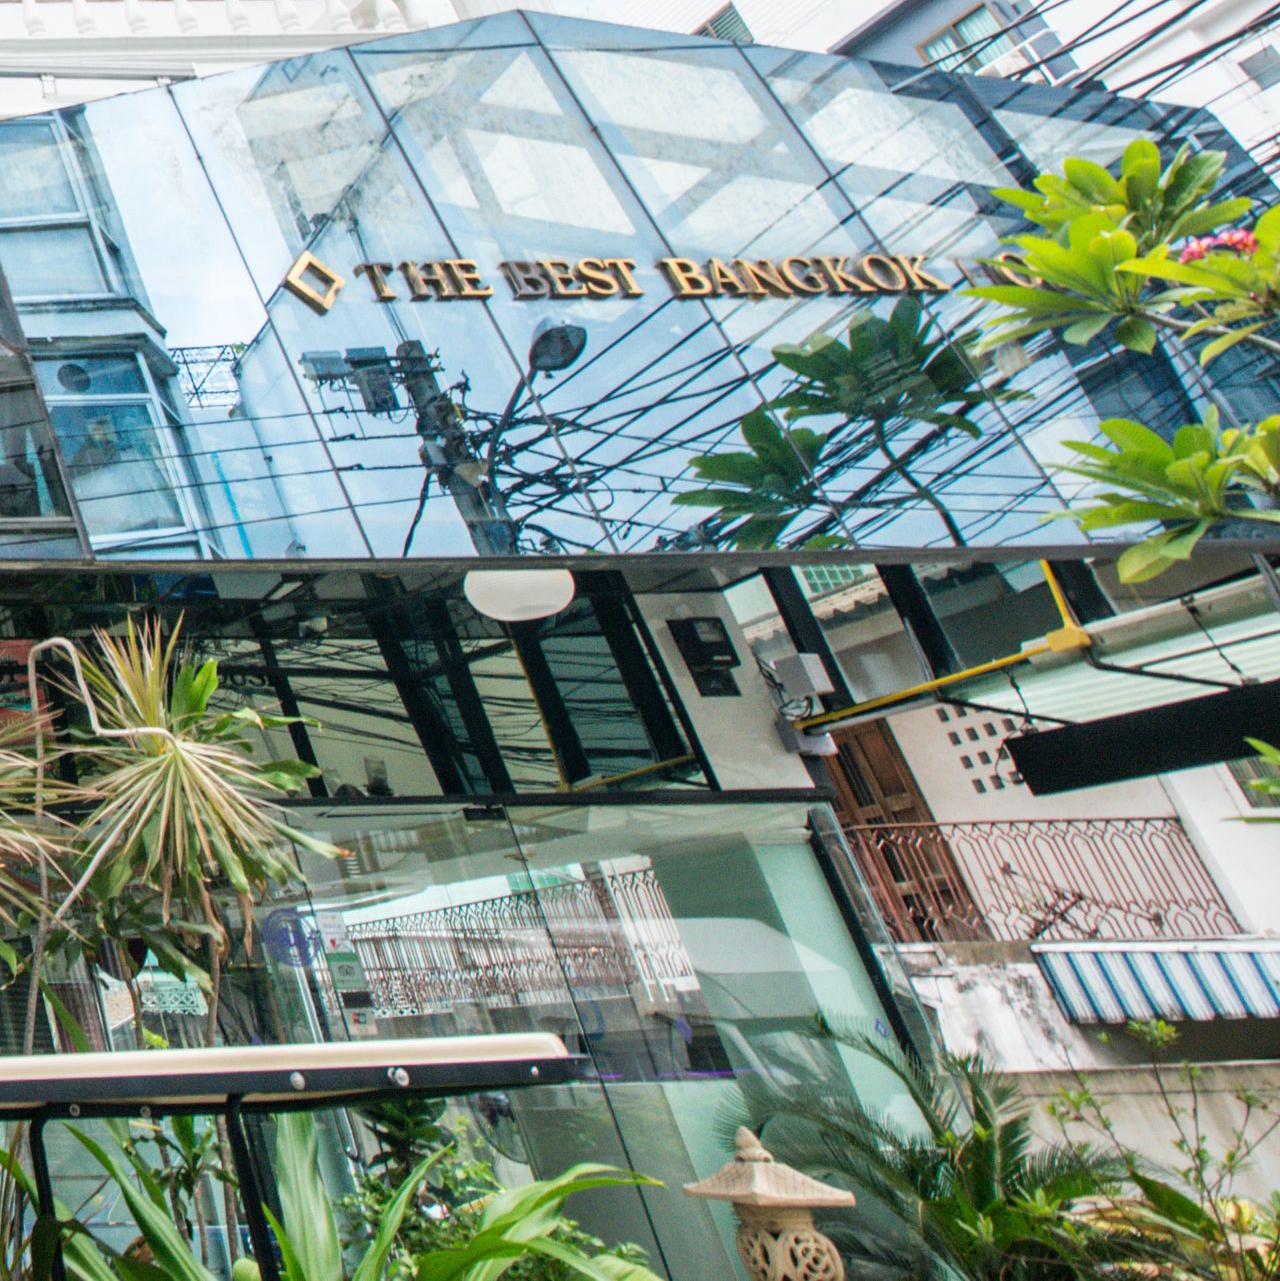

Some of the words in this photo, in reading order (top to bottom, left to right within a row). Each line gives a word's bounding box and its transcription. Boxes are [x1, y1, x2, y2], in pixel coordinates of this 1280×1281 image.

[353, 259, 494, 301] THE
[498, 258, 645, 300] BEST
[656, 254, 952, 298] BANGKOK
